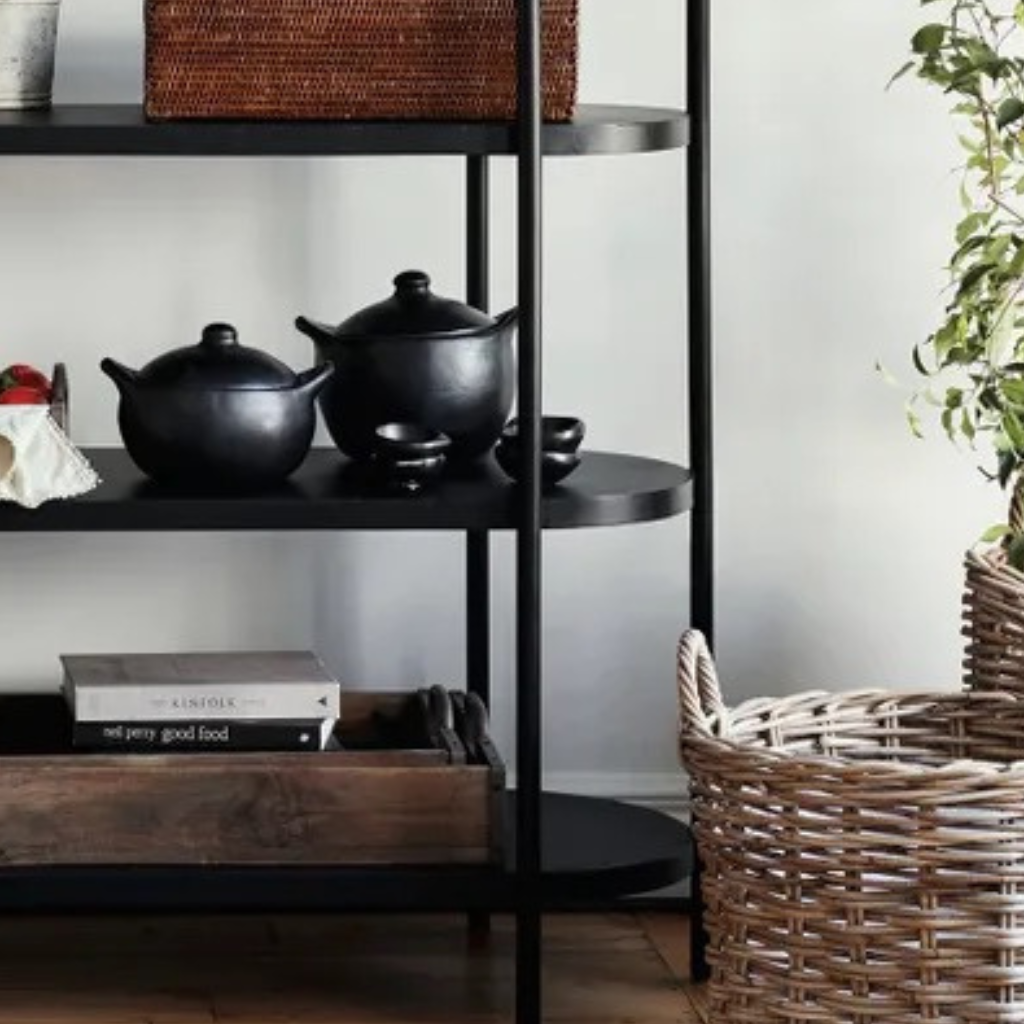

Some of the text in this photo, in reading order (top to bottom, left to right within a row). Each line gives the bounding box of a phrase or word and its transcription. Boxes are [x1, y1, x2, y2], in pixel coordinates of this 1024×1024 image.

[171, 696, 237, 709] KINFOLK
[160, 725, 196, 744] good
[198, 725, 230, 742] food
